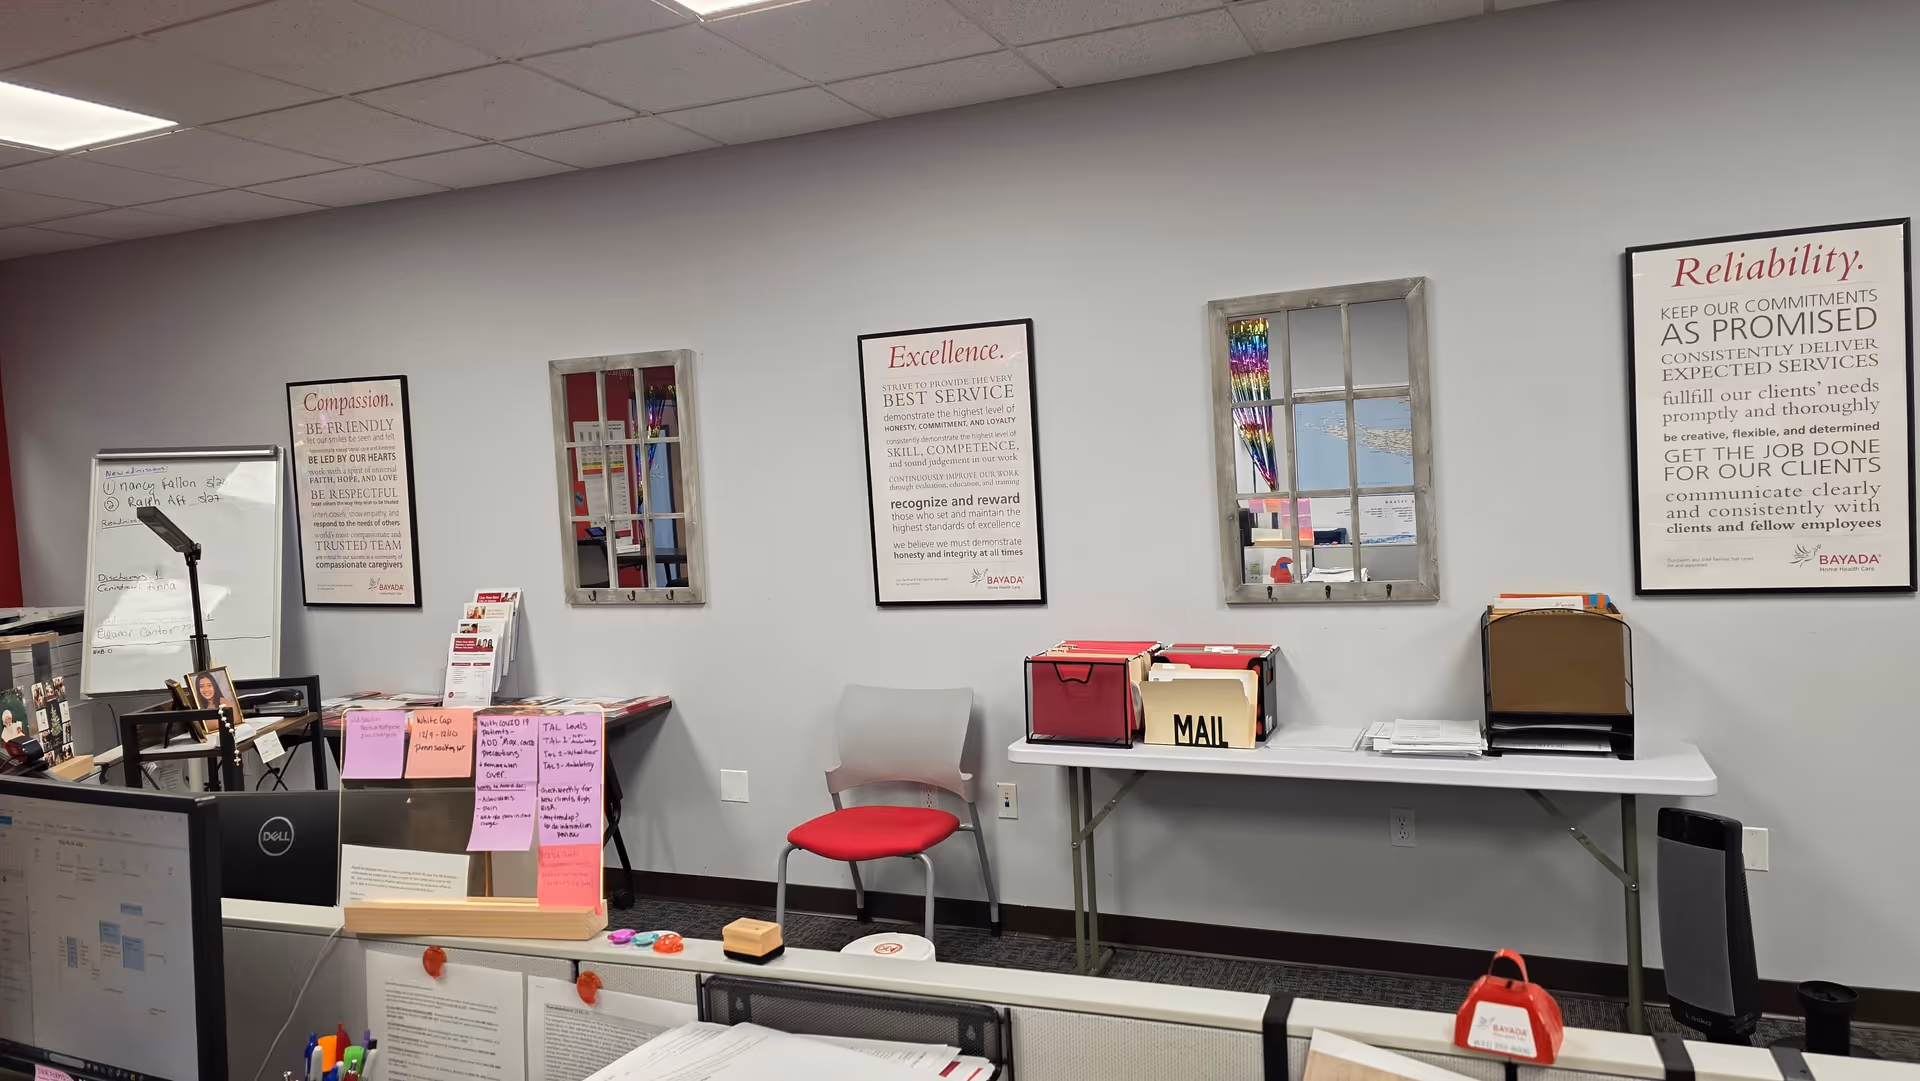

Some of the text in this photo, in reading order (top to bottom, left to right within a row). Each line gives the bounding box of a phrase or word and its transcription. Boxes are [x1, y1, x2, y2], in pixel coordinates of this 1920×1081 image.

[1671, 243, 1864, 288] Reliability.
[1661, 288, 1878, 320] KEEP OUR COMMITMENTS
[1661, 307, 1878, 346] AS PROMISED
[888, 339, 1004, 369] Excellence.
[1661, 338, 1879, 365] CONSISTENTLY DELIVER
[1662, 353, 1879, 382] EXPECTED SERVICES
[883, 383, 913, 392] STRIVE
[930, 379, 969, 388] PROVIDE
[990, 375, 1013, 383] VERY
[1663, 389, 1713, 406] fullfill
[1720, 391, 1751, 401] our
[1828, 378, 1880, 395] needs
[304, 389, 394, 416] Compassion.
[883, 384, 1015, 408] BEST SERVICE
[884, 404, 1015, 422] demonstrate the highest level of
[1663, 397, 1880, 427] promptly and thoroughly
[306, 419, 394, 435] BE FRIENDLY
[919, 421, 968, 430] COMMITMENT,
[987, 417, 1016, 425] LOYALTY
[1664, 421, 1880, 442] be creative, flexible, and determined
[886, 436, 920, 445] consistently
[921, 434, 958, 443] demonstrate
[972, 431, 993, 440] highest
[887, 441, 1019, 458] SKILL, COMPETENCE,
[1665, 439, 1880, 464] GET THE JOB DONE
[309, 453, 396, 464] BE LED BY OUR HEARTS
[889, 460, 902, 468] and
[905, 458, 927, 467] sound
[928, 456, 970, 468] judgement
[972, 455, 980, 463] in
[998, 453, 1018, 461] work
[889, 474, 944, 483] CONTINUOUSLY
[947, 472, 977, 480] IMPROVE
[979, 471, 996, 479] OUR
[1665, 457, 1881, 481] FOR OUR CLIENTS
[311, 488, 398, 500] BE RESPECTFUL
[1666, 481, 1881, 503] communicate clearly
[891, 493, 1020, 510] recognize and reward
[1667, 498, 1880, 519] and consistently with
[892, 508, 1021, 521] those who set and maintain the
[892, 519, 1021, 534] highest standards of excellence
[1667, 519, 1882, 534] clients and fellow employees
[315, 540, 402, 551] TRUSTED TEAM
[908, 540, 935, 549] believe
[951, 539, 970, 547] must
[972, 537, 1022, 547] demonstrate
[894, 551, 925, 560] honesty
[927, 550, 942, 558] and
[943, 550, 977, 559] integrity
[369, 561, 403, 570] caregivers
[1174, 714, 1228, 748] MAIL
[263, 831, 290, 842] DELL
